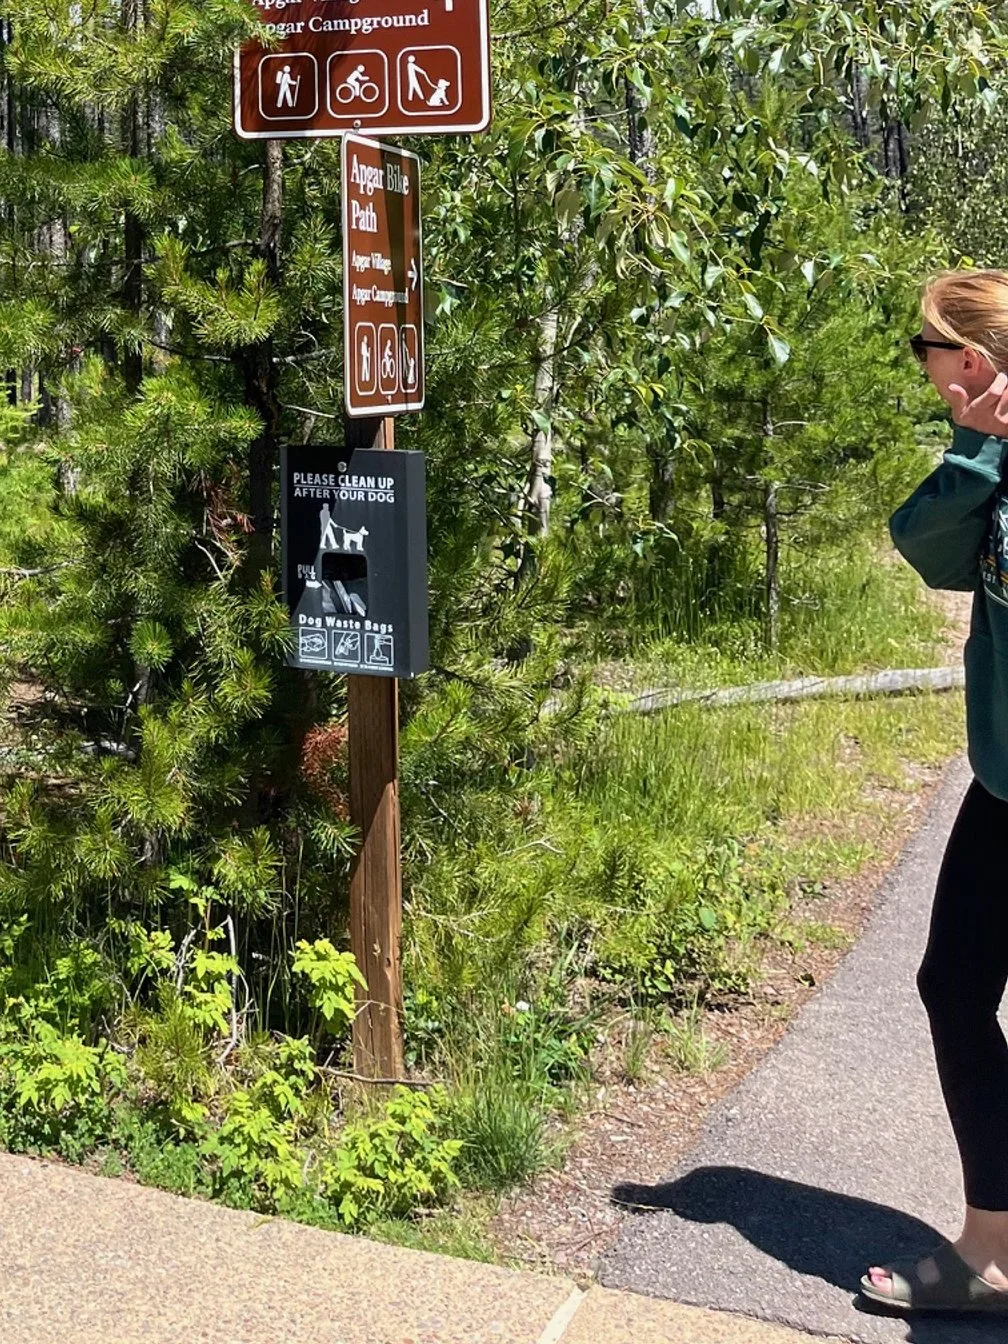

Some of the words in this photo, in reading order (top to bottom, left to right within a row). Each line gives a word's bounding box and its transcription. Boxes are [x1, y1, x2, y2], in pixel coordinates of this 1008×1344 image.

[256, 19, 305, 40] pgar
[308, 9, 430, 35] Campground
[351, 154, 384, 195] Apgar
[387, 163, 409, 195] Bike
[351, 200, 377, 232] Path
[351, 249, 371, 272] Apgar
[371, 253, 392, 275] Village
[351, 282, 372, 305] Apgar
[293, 472, 335, 486] PLEASE
[338, 474, 376, 488] CLEAN
[377, 477, 395, 490] UP
[294, 487, 330, 499] AFTER
[332, 489, 366, 501] YOUR
[367, 491, 395, 504] DOG
[297, 564, 315, 575] PULL
[298, 613, 323, 628] Dog
[325, 616, 361, 629] Waste
[364, 620, 394, 635] Bags
